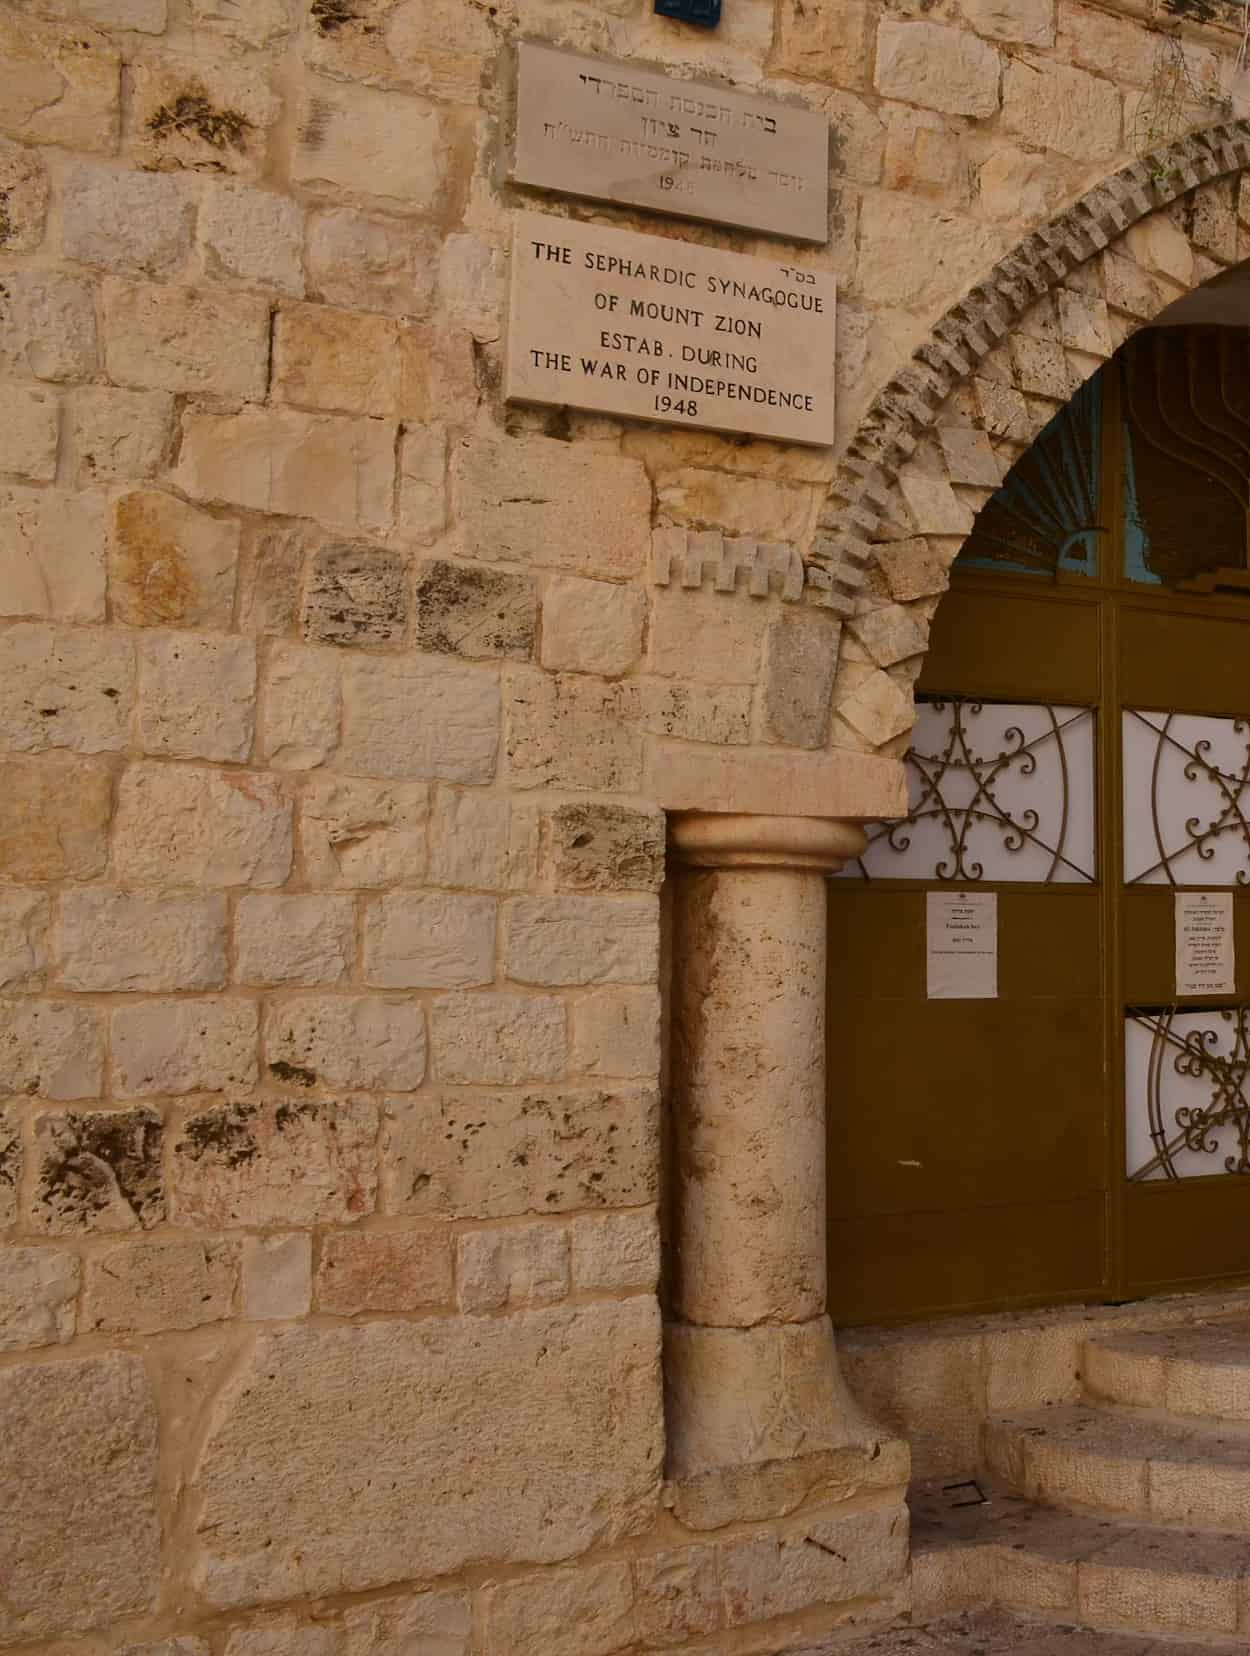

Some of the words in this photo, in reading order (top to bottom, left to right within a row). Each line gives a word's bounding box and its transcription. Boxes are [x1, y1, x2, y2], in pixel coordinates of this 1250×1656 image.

[578, 72, 660, 105] הספרדי
[669, 93, 733, 122] הכנסת
[640, 116, 681, 138] ציון
[689, 127, 719, 146] הר
[744, 112, 777, 135] בית
[531, 241, 572, 265] THE
[585, 252, 697, 289] SEPHARDIC
[707, 276, 824, 313] SYNAGOGUE
[594, 292, 619, 312] OF
[630, 299, 704, 327] MOUNT
[714, 315, 762, 339] ZION
[600, 331, 672, 357] ESTAB.
[682, 345, 758, 373] DURING
[530, 349, 572, 372] THE
[580, 357, 627, 382] WAR
[637, 368, 661, 386] OF
[668, 373, 813, 412] INDEPENDENCE
[655, 395, 698, 417] 1948
